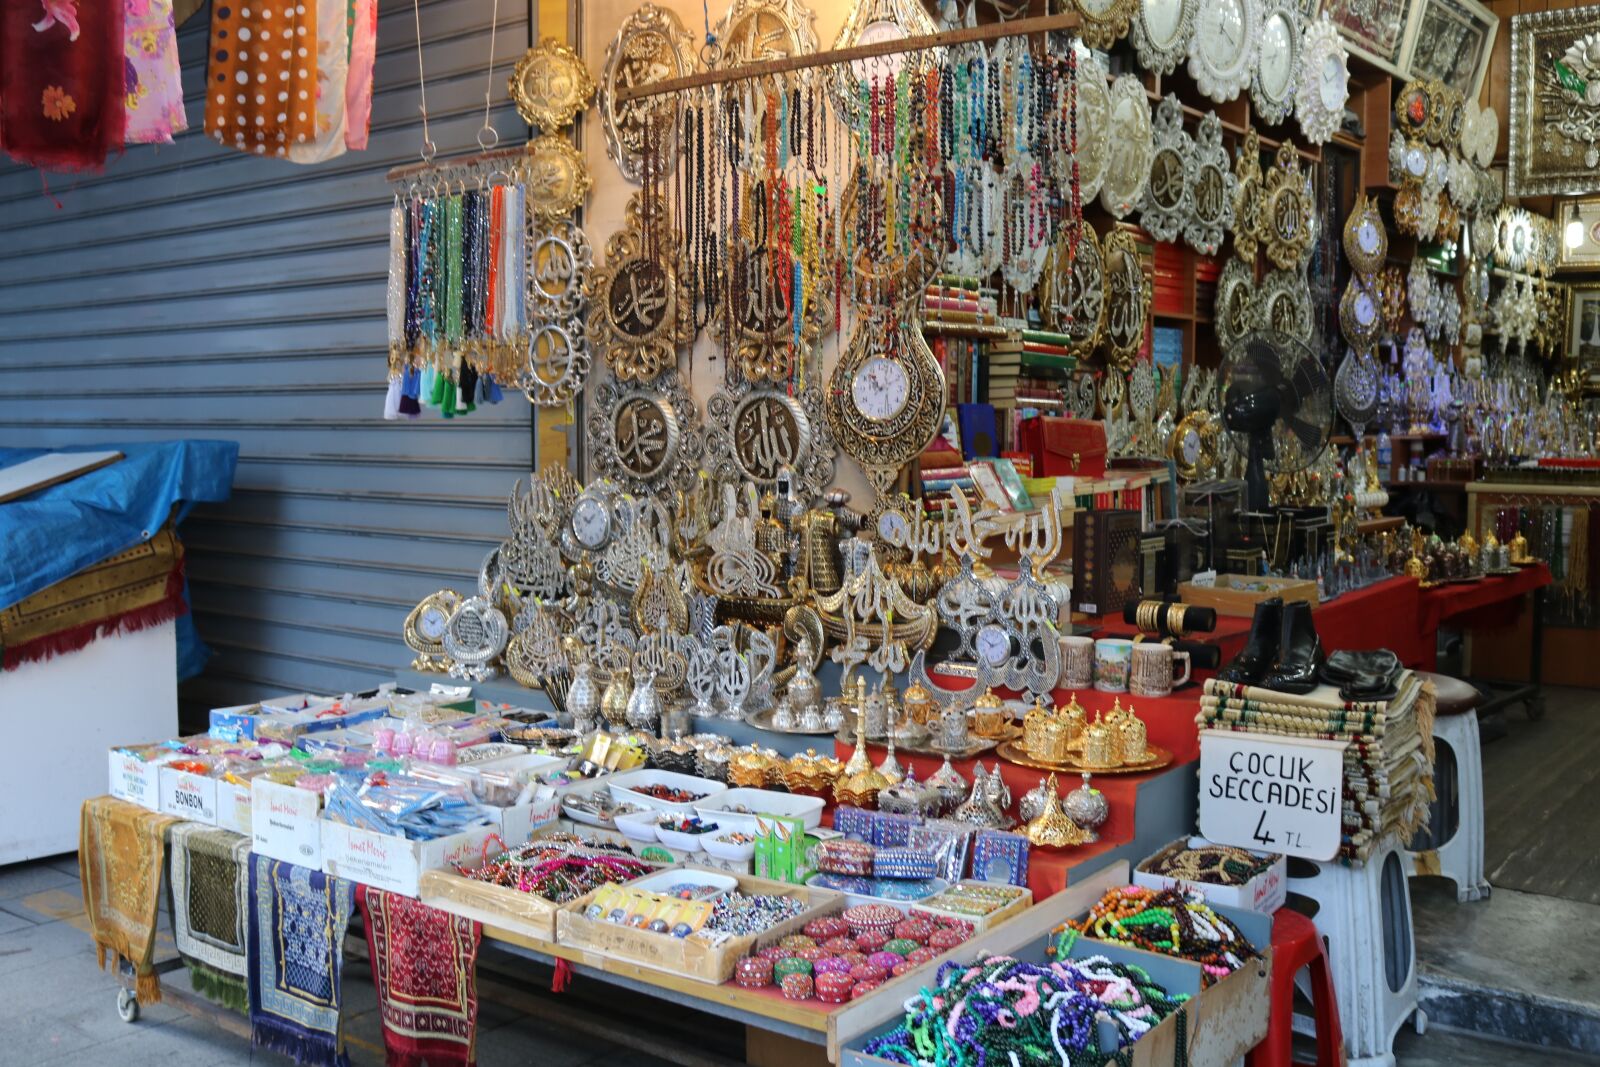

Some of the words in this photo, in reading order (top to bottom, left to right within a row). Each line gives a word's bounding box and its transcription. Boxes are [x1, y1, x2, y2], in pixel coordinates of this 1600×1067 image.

[1229, 751, 1314, 783] ÇOCUK
[175, 790, 203, 810] BONBON
[1209, 774, 1336, 814] SECCADESİ
[1253, 809, 1276, 845] 4
